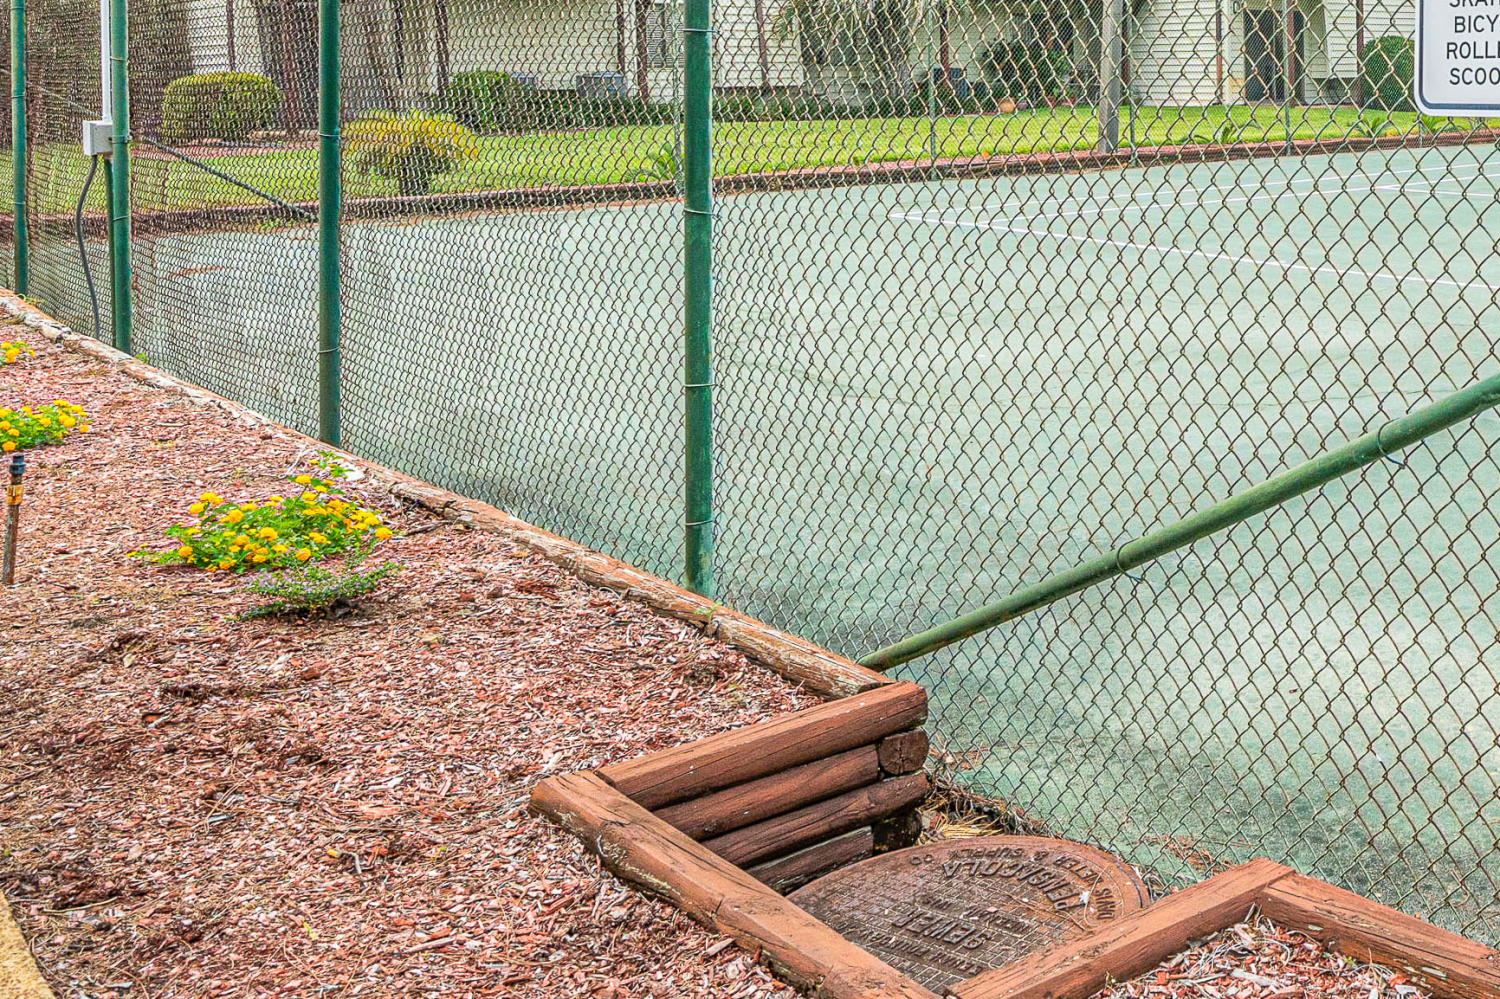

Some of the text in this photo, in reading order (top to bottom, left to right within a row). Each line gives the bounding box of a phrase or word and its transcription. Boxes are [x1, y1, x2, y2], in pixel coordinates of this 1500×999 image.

[942, 859, 1087, 910] PENSACOLA
[1095, 887, 1116, 920] DAVIS
[891, 903, 993, 950] SEWER
